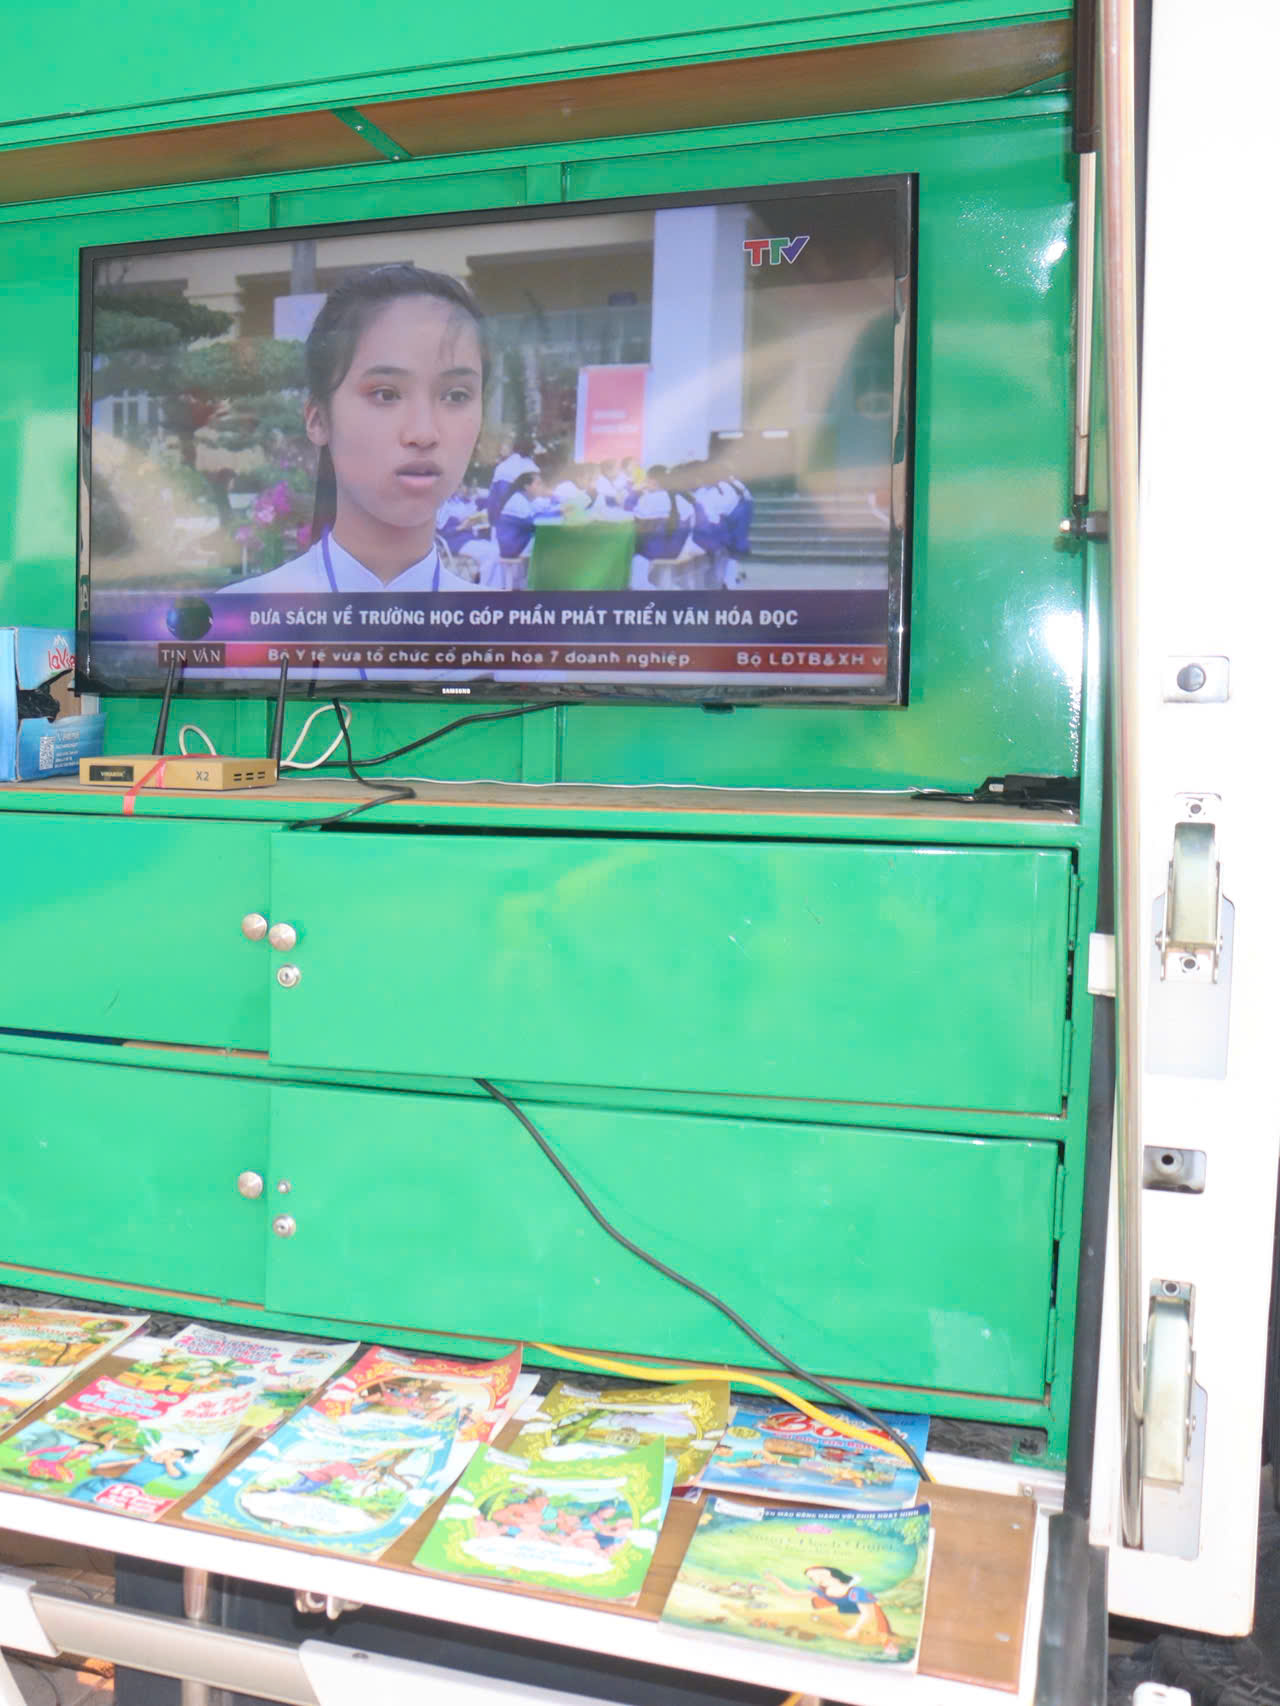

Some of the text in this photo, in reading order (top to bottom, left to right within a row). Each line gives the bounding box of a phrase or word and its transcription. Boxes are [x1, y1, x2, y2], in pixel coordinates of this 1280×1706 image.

[743, 235, 810, 267] TTV
[250, 608, 281, 625] ĐƯA
[285, 606, 328, 625] SÁCH
[332, 604, 353, 625] VỀ
[359, 605, 425, 625] TRƯỜNG
[429, 609, 465, 628] HỌC
[469, 605, 504, 625] GÓP
[561, 605, 608, 625] PHÁT
[613, 602, 668, 626] TRIỂN
[714, 605, 754, 626] HÓA
[759, 609, 800, 628] ĐỌC
[160, 649, 187, 662] TIN
[296, 650, 306, 661] Y
[549, 650, 559, 663] 7
[564, 650, 620, 665] doanh
[769, 652, 865, 666] LĐTB&XH
[442, 687, 471, 695] SAMSUNG
[196, 770, 210, 782] X2
